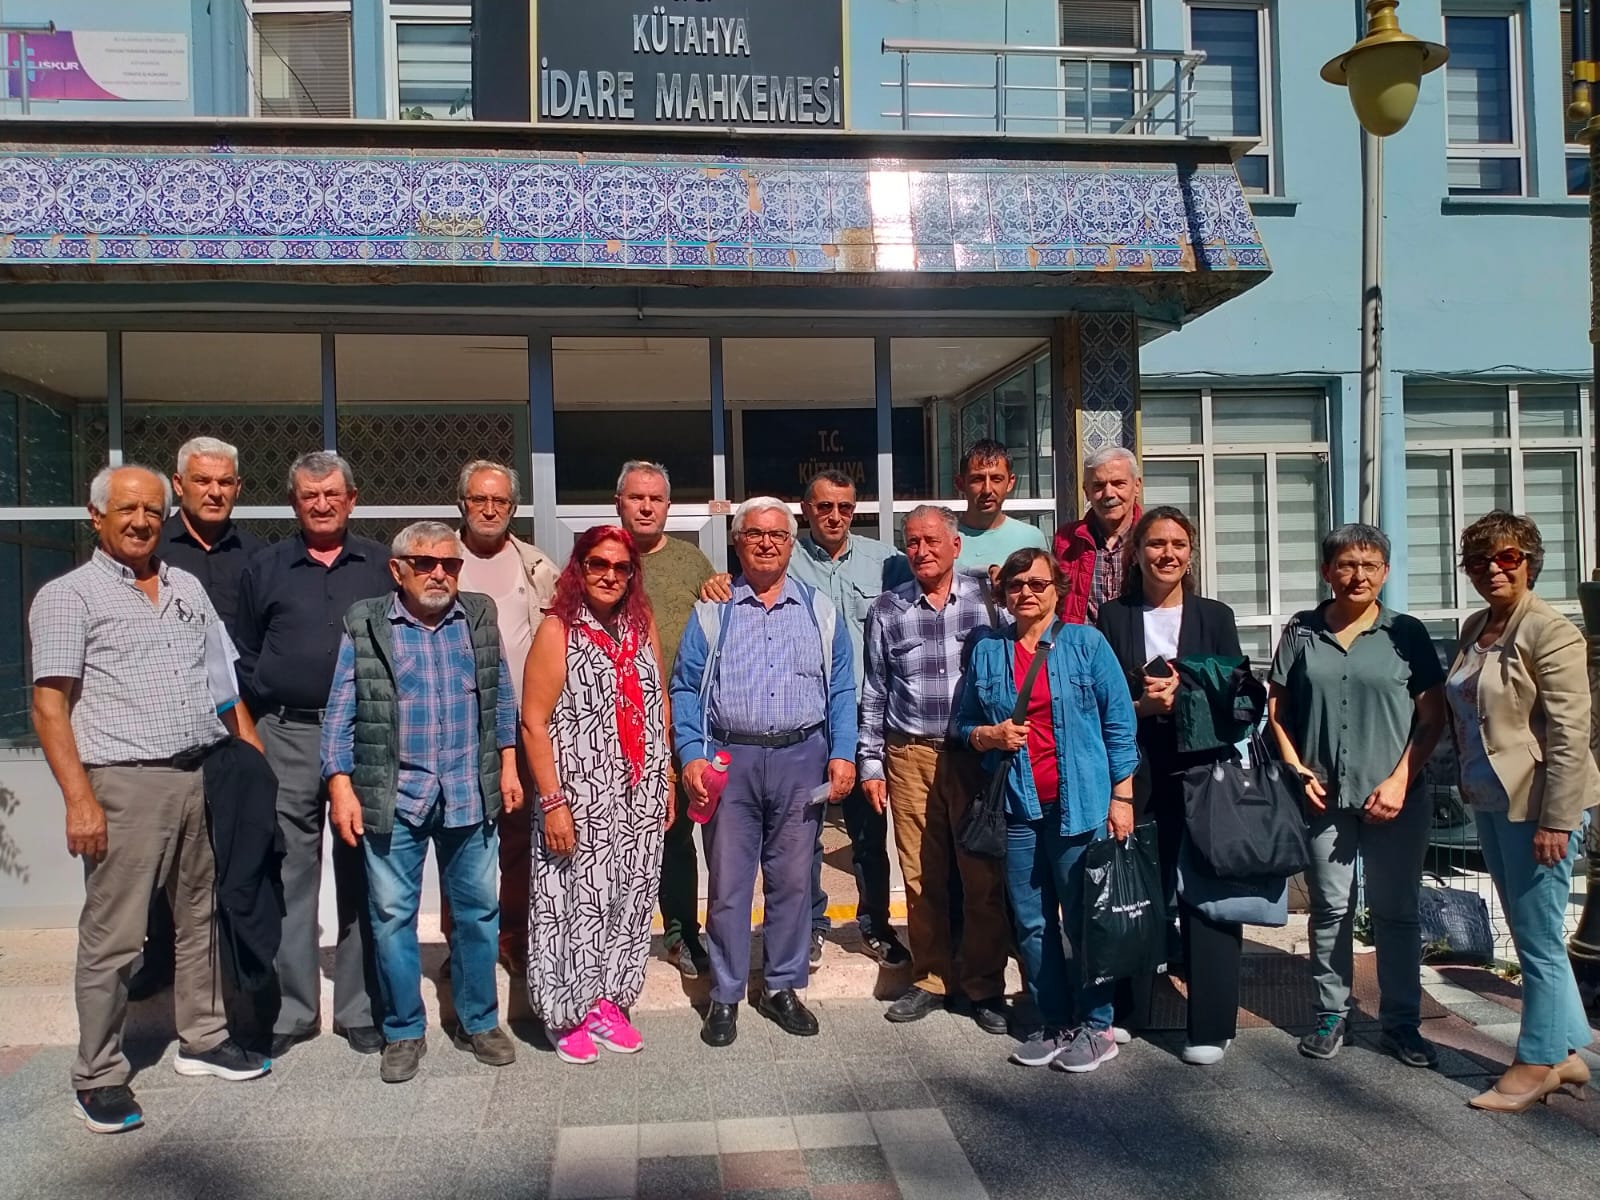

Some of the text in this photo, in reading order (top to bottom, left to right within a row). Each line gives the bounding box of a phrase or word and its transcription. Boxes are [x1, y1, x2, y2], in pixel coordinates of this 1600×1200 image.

[632, 6, 751, 56] KÜTAHYA
[540, 57, 842, 125] İDARE MAHKEMESİ
[817, 429, 844, 452] T.C.
